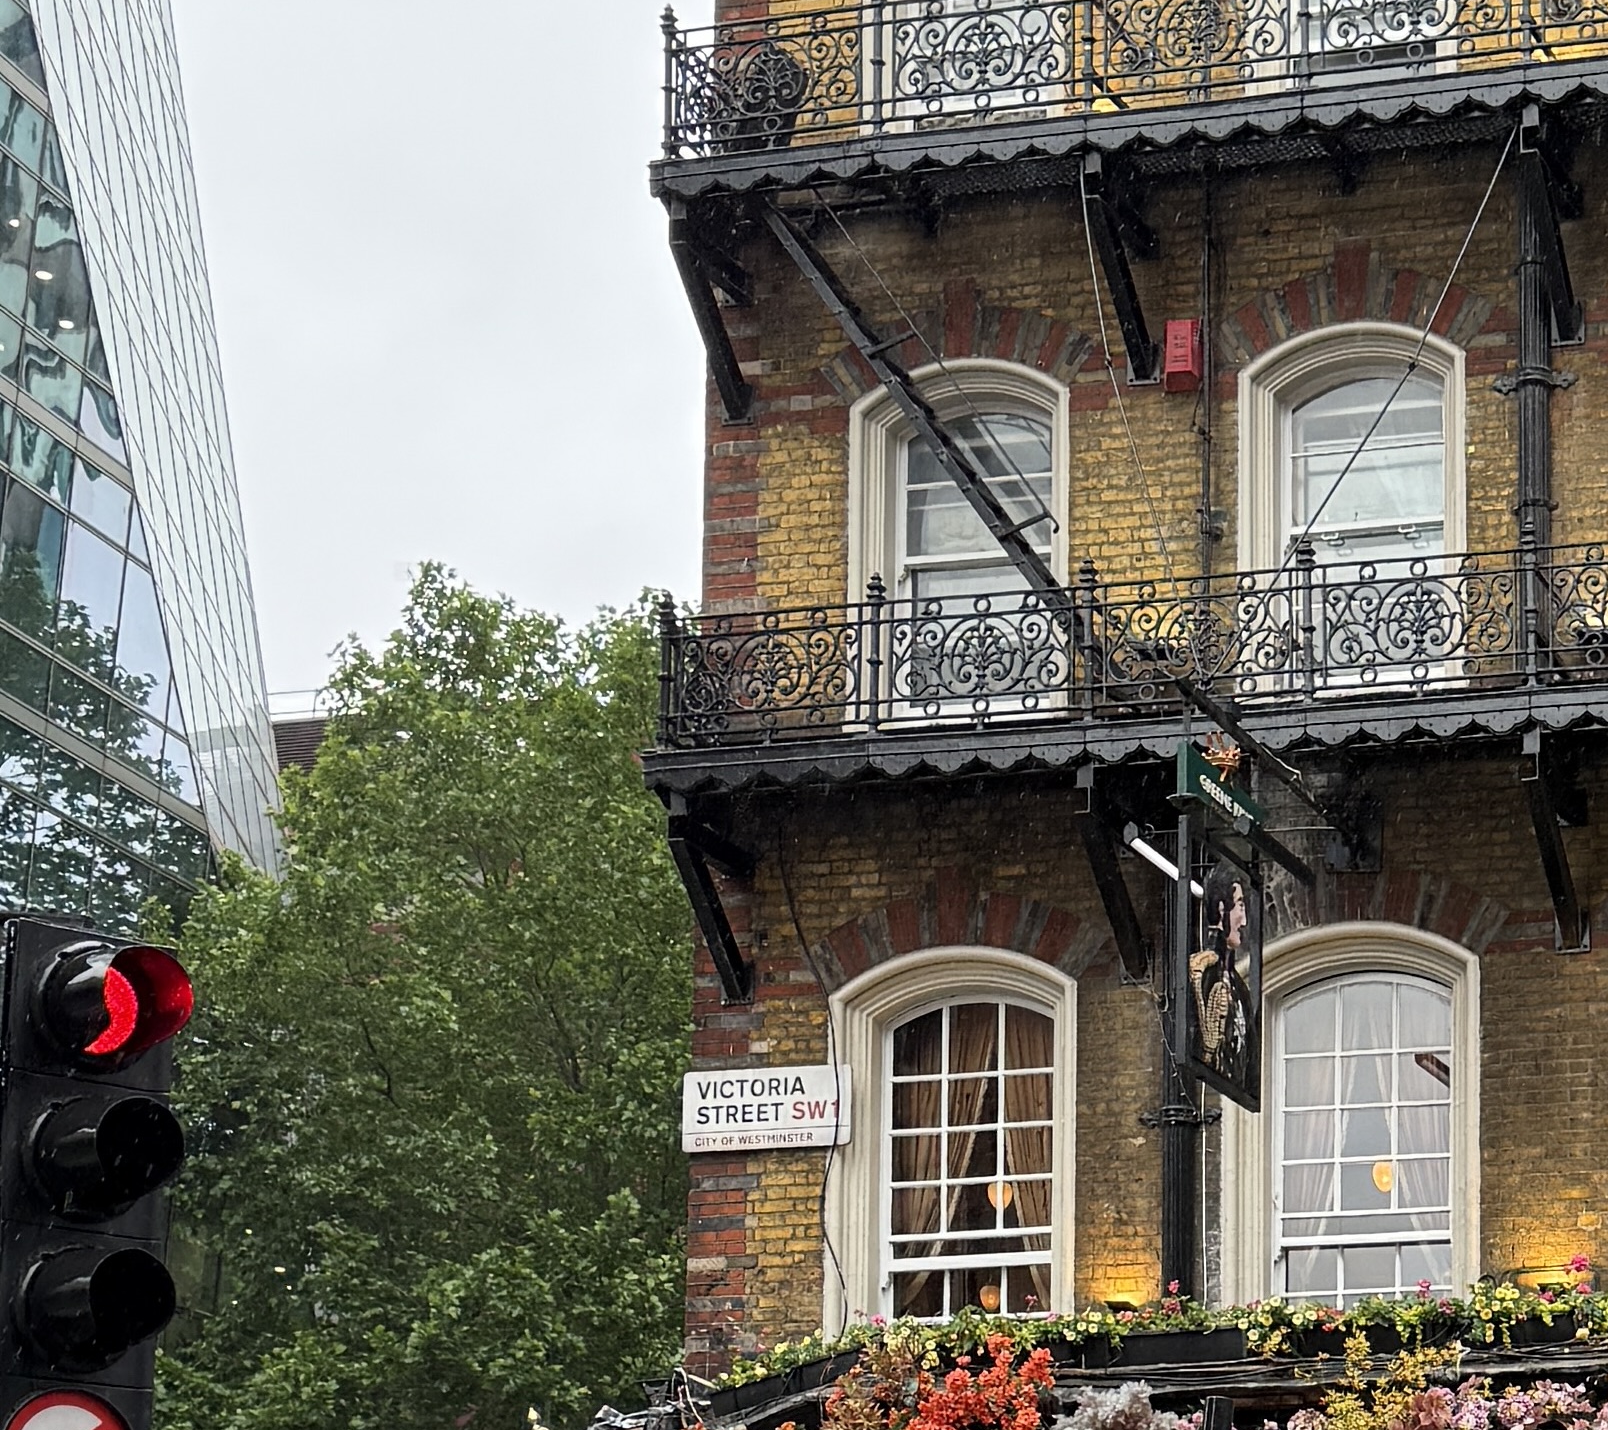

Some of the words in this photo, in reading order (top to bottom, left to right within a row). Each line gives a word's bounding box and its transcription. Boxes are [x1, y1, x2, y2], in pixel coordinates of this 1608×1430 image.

[1199, 774, 1233, 813] GREENE
[697, 1076, 806, 1100] VICTORIA
[696, 1102, 784, 1124] STREET
[694, 1136, 718, 1147] CITY
[721, 1136, 735, 1146] OF
[738, 1132, 814, 1145] WESTMINSTER
